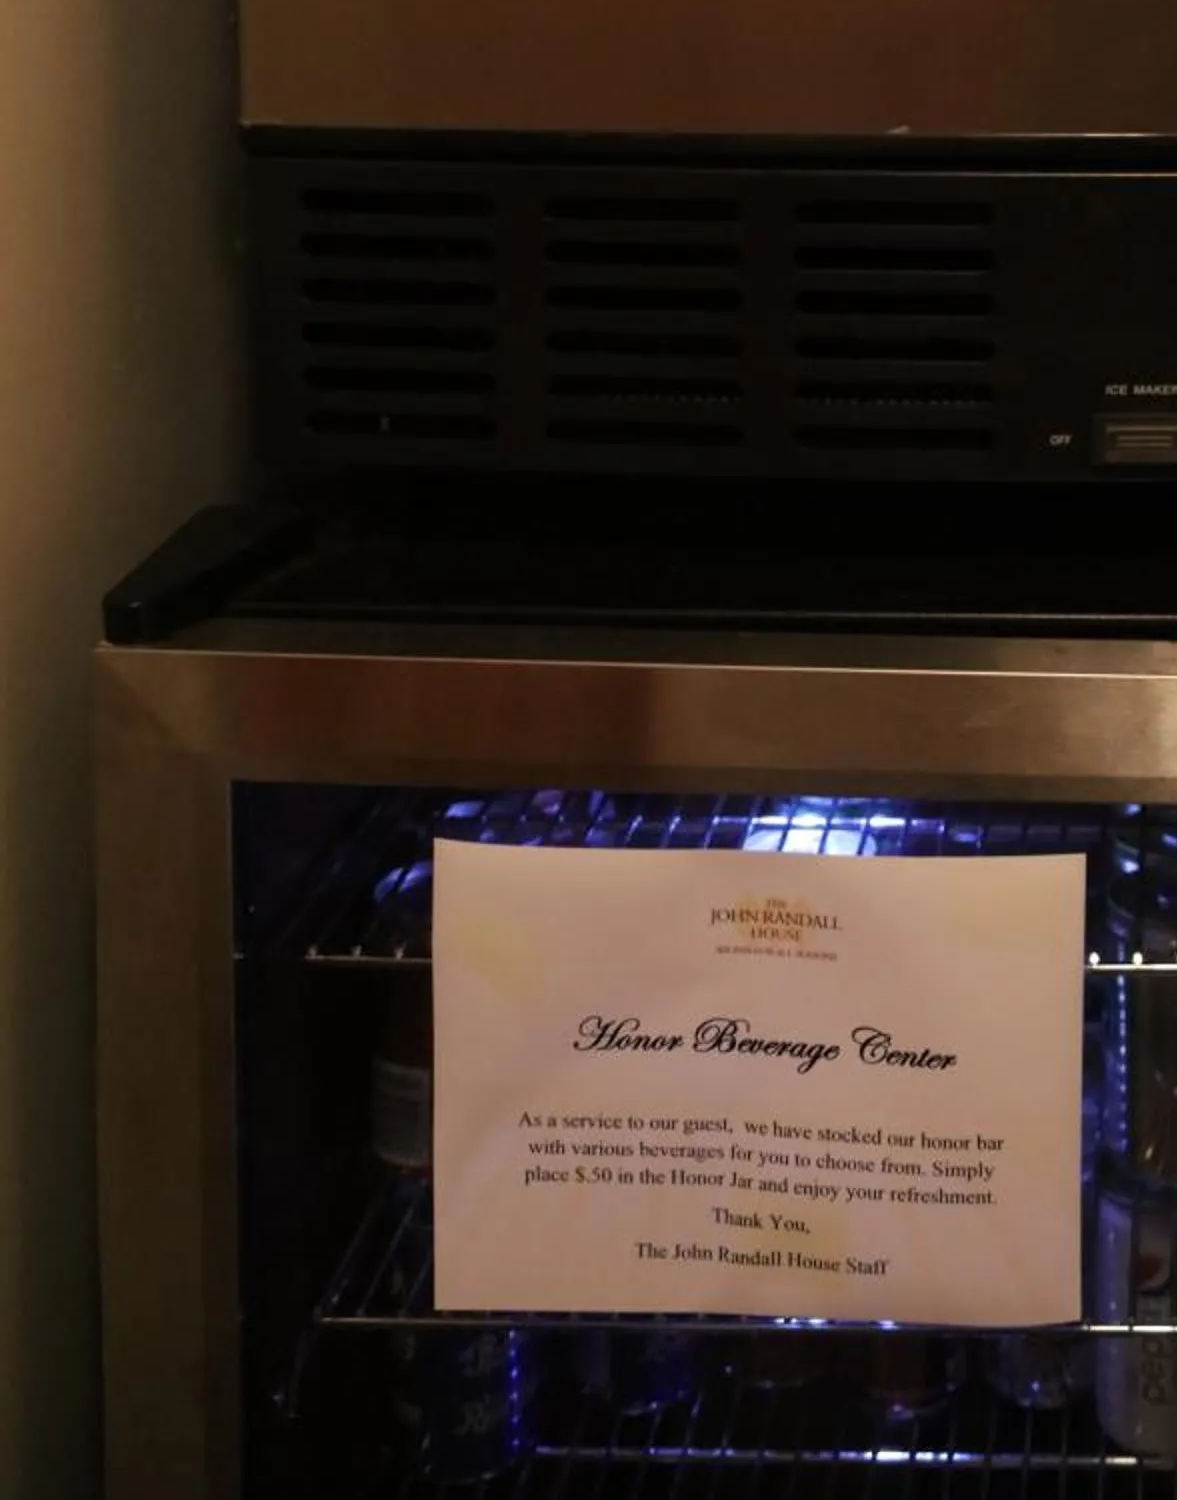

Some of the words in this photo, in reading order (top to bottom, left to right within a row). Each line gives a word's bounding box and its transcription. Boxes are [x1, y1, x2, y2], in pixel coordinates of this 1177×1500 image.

[1105, 384, 1129, 396] ICE
[1049, 434, 1073, 446] OFF
[711, 908, 759, 925] JOHN
[763, 910, 843, 931] RANDALL
[750, 927, 802, 942] HOUSE
[573, 1015, 685, 1053] Honor
[693, 1016, 842, 1075] Beverage
[851, 1025, 958, 1072] Center
[518, 1111, 542, 1129] As
[549, 1116, 558, 1129] a
[562, 1114, 622, 1130] service
[627, 1115, 646, 1130] to
[649, 1118, 679, 1131] our
[682, 1117, 733, 1135] guest,
[744, 1122, 769, 1135] we
[773, 1120, 812, 1140] have
[817, 1126, 882, 1146] stocked
[887, 1135, 916, 1148] our
[920, 1131, 971, 1150] honor
[976, 1134, 1005, 1151] bar
[528, 1139, 566, 1156] with
[571, 1140, 634, 1157] various
[639, 1141, 726, 1163] beverages
[730, 1143, 754, 1161] for
[756, 1151, 789, 1168] you
[794, 1152, 812, 1169] to
[816, 1153, 876, 1173] choose
[880, 1157, 925, 1177] from.
[931, 1159, 996, 1182] Simply
[524, 1164, 570, 1186] place
[574, 1165, 613, 1184] $.50
[617, 1168, 635, 1184] in
[638, 1168, 666, 1185] the
[670, 1169, 725, 1187] Honor
[729, 1171, 754, 1190] Jar
[757, 1178, 789, 1194] and
[793, 1180, 840, 1201] enjoy
[845, 1185, 885, 1202] your
[890, 1186, 998, 1206] refreshment.
[711, 1206, 764, 1230] Thank
[769, 1213, 811, 1235] You,
[634, 1242, 667, 1259] The
[671, 1243, 713, 1262] John
[717, 1246, 782, 1268] Randall
[787, 1251, 841, 1273] House
[846, 1256, 890, 1277] Staff
